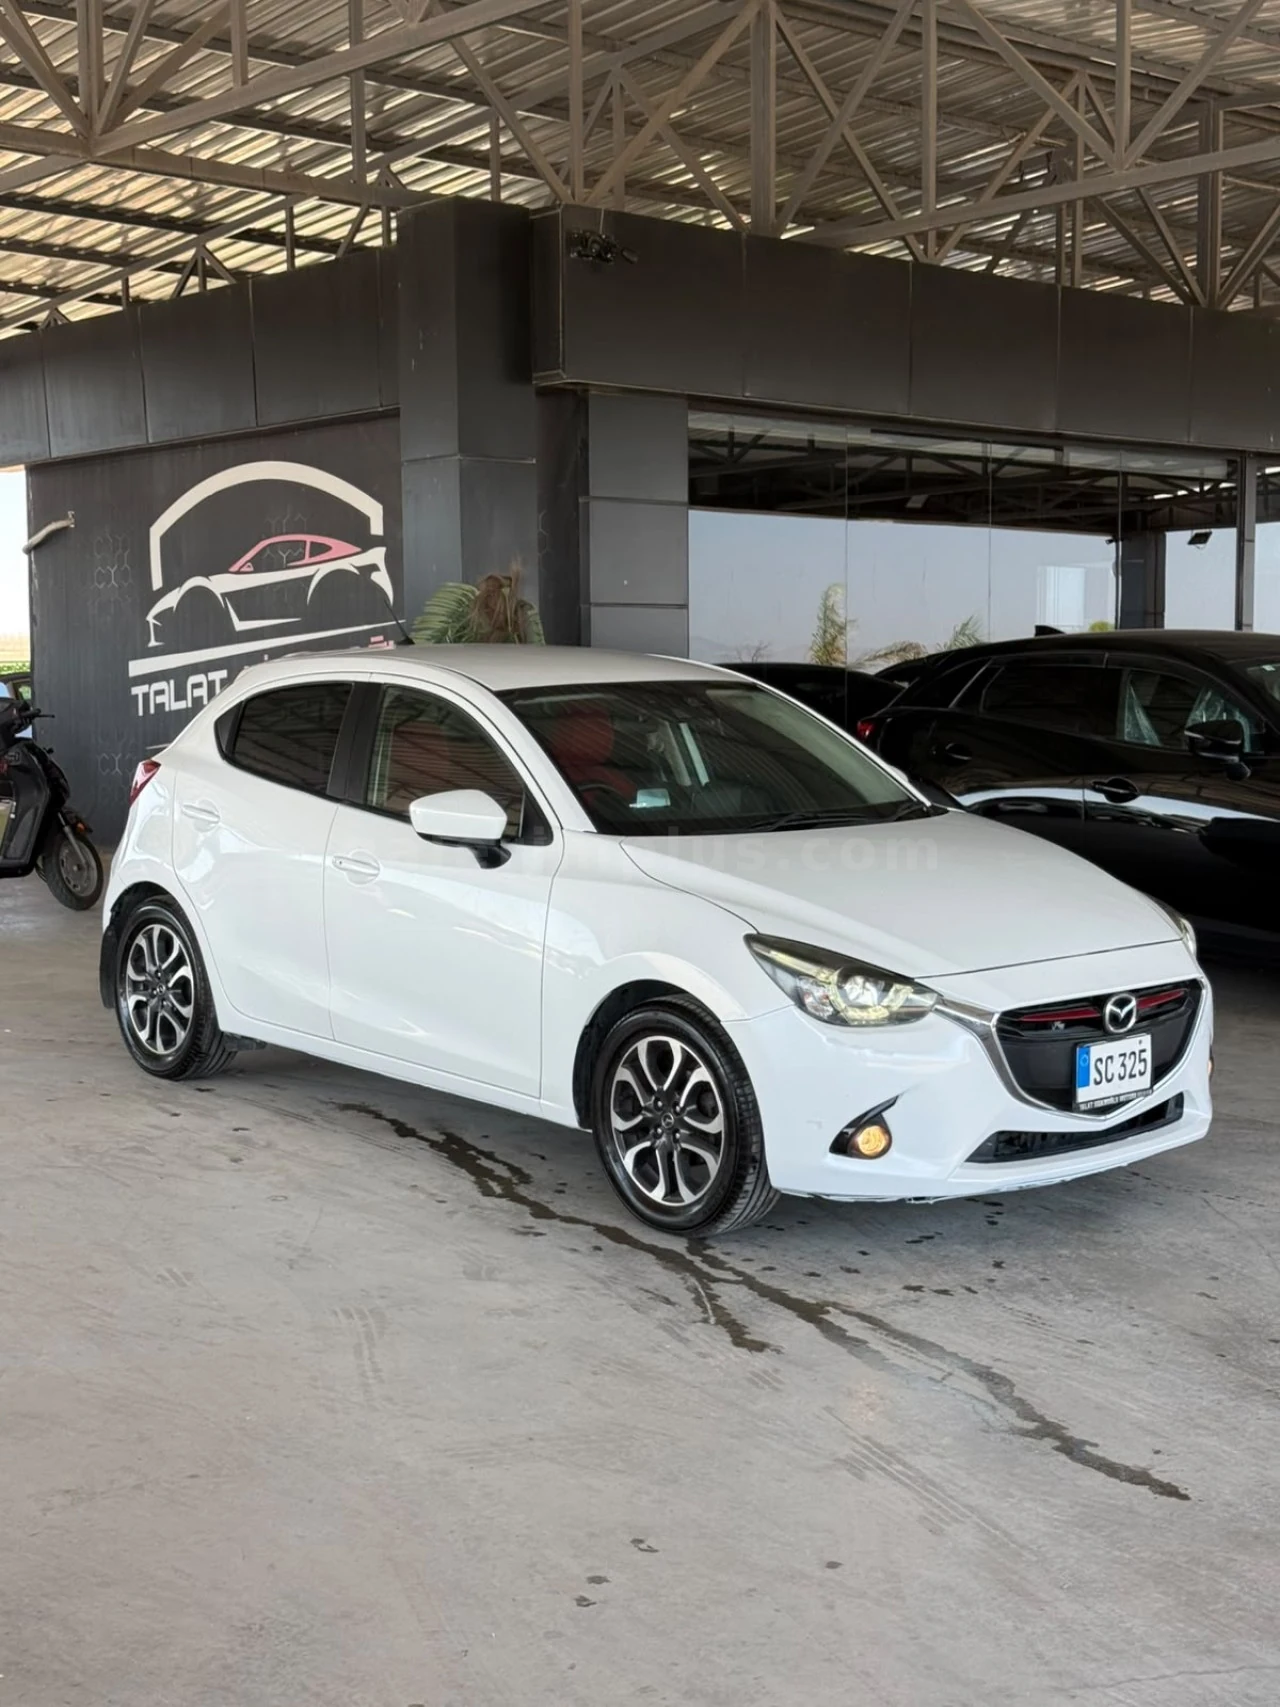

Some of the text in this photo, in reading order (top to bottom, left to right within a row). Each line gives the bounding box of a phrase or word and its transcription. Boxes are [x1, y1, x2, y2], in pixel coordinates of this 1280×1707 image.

[131, 669, 228, 717] TALAT
[1094, 1049, 1147, 1085] SC 325
